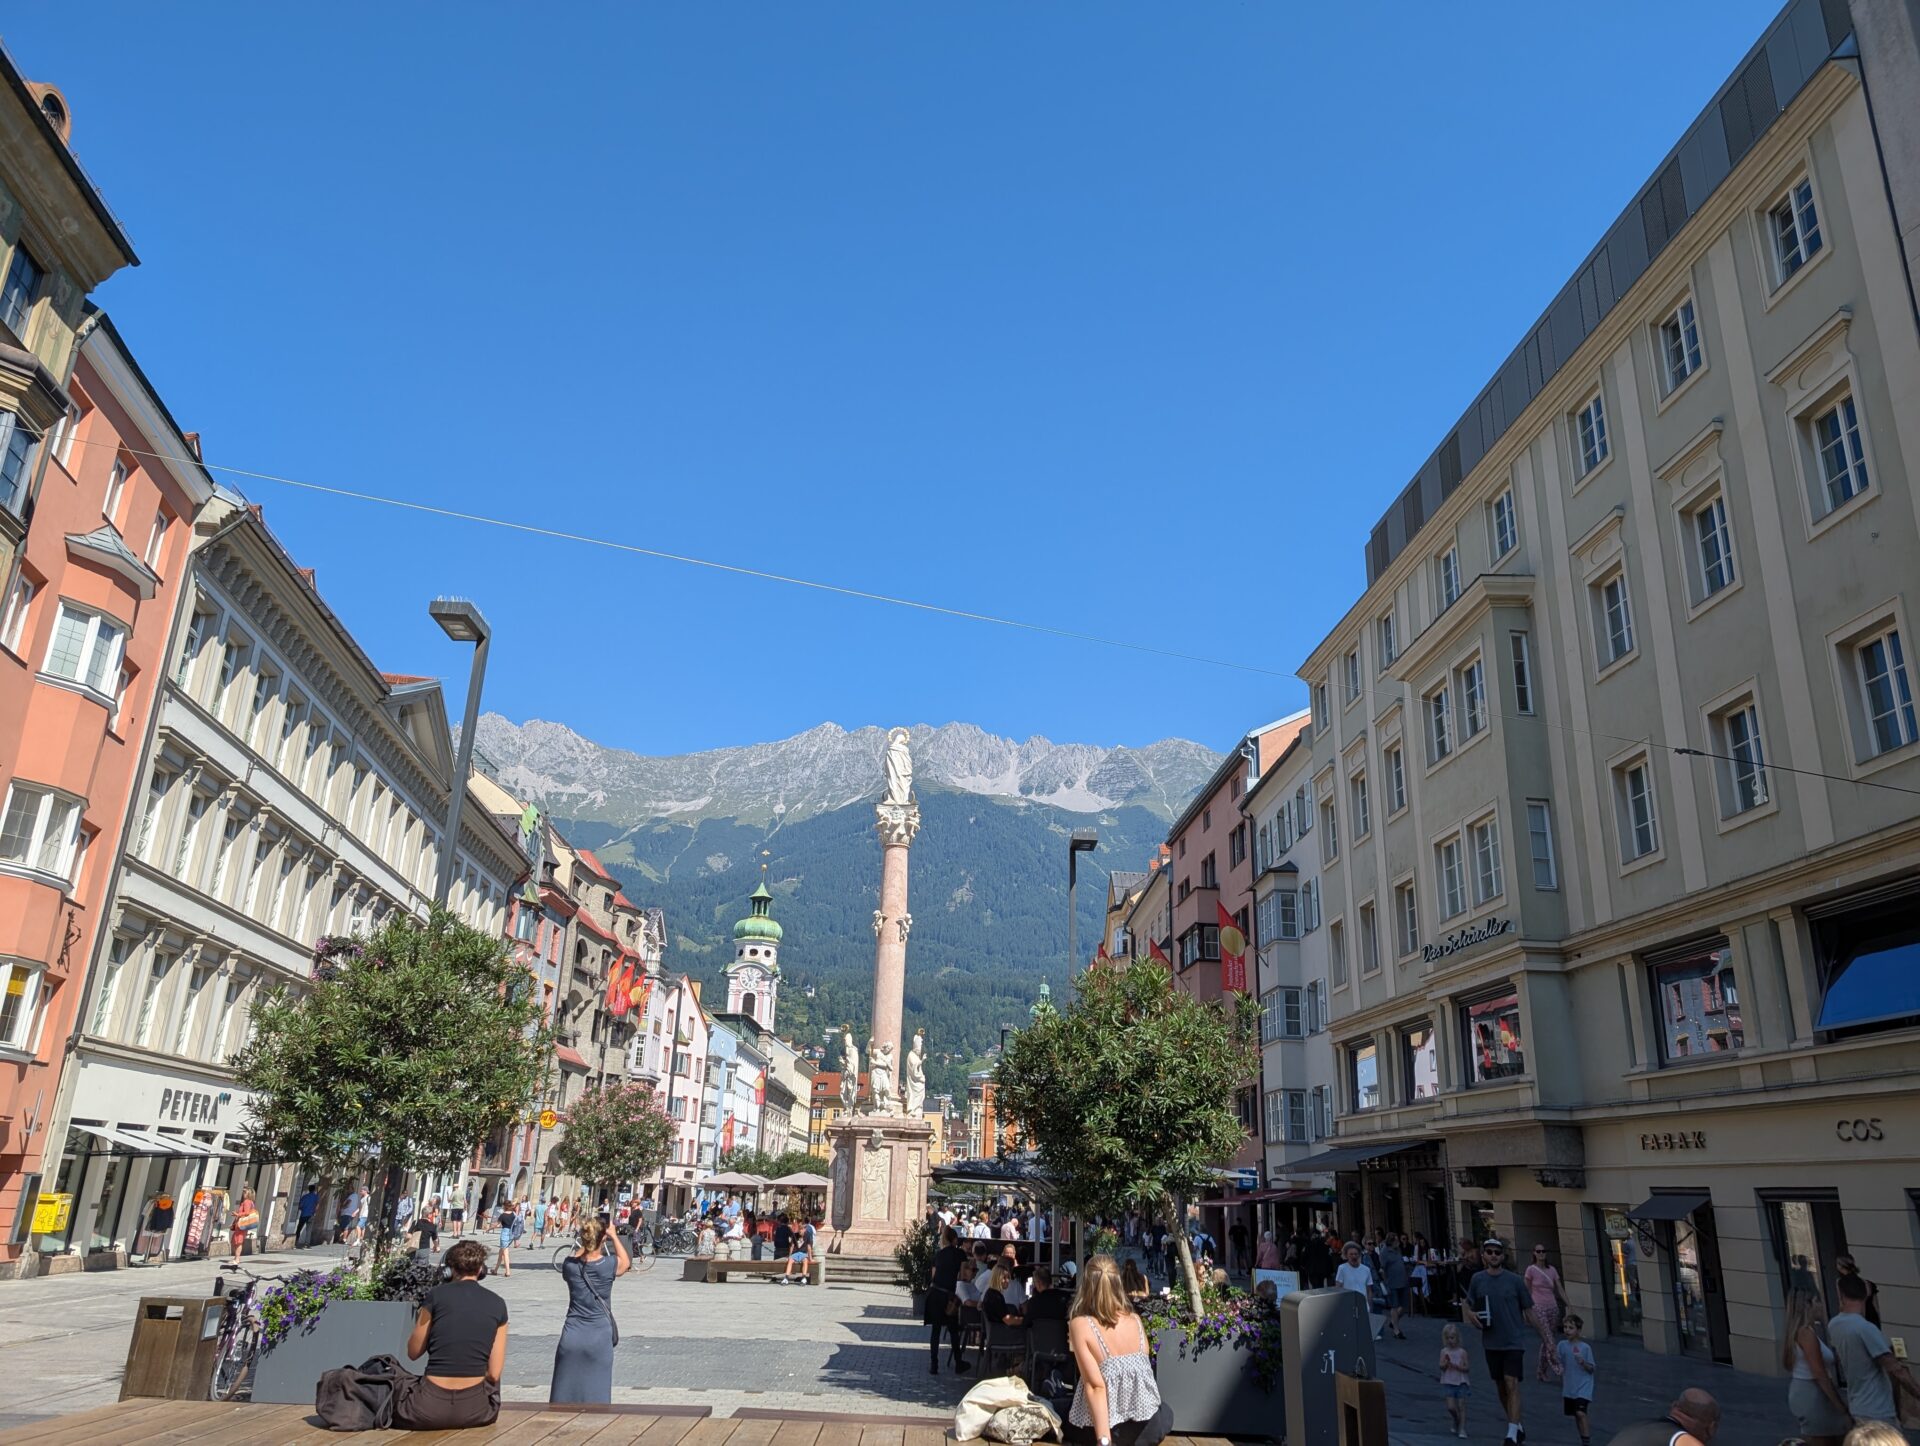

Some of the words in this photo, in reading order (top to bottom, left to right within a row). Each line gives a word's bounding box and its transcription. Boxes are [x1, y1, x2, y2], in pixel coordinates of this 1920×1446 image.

[1421, 943, 1444, 963] Das
[1443, 917, 1511, 956] Schindler
[158, 1087, 219, 1125] PETERA
[1639, 1130, 1706, 1150] TABAK
[1836, 1117, 1884, 1142] COS
